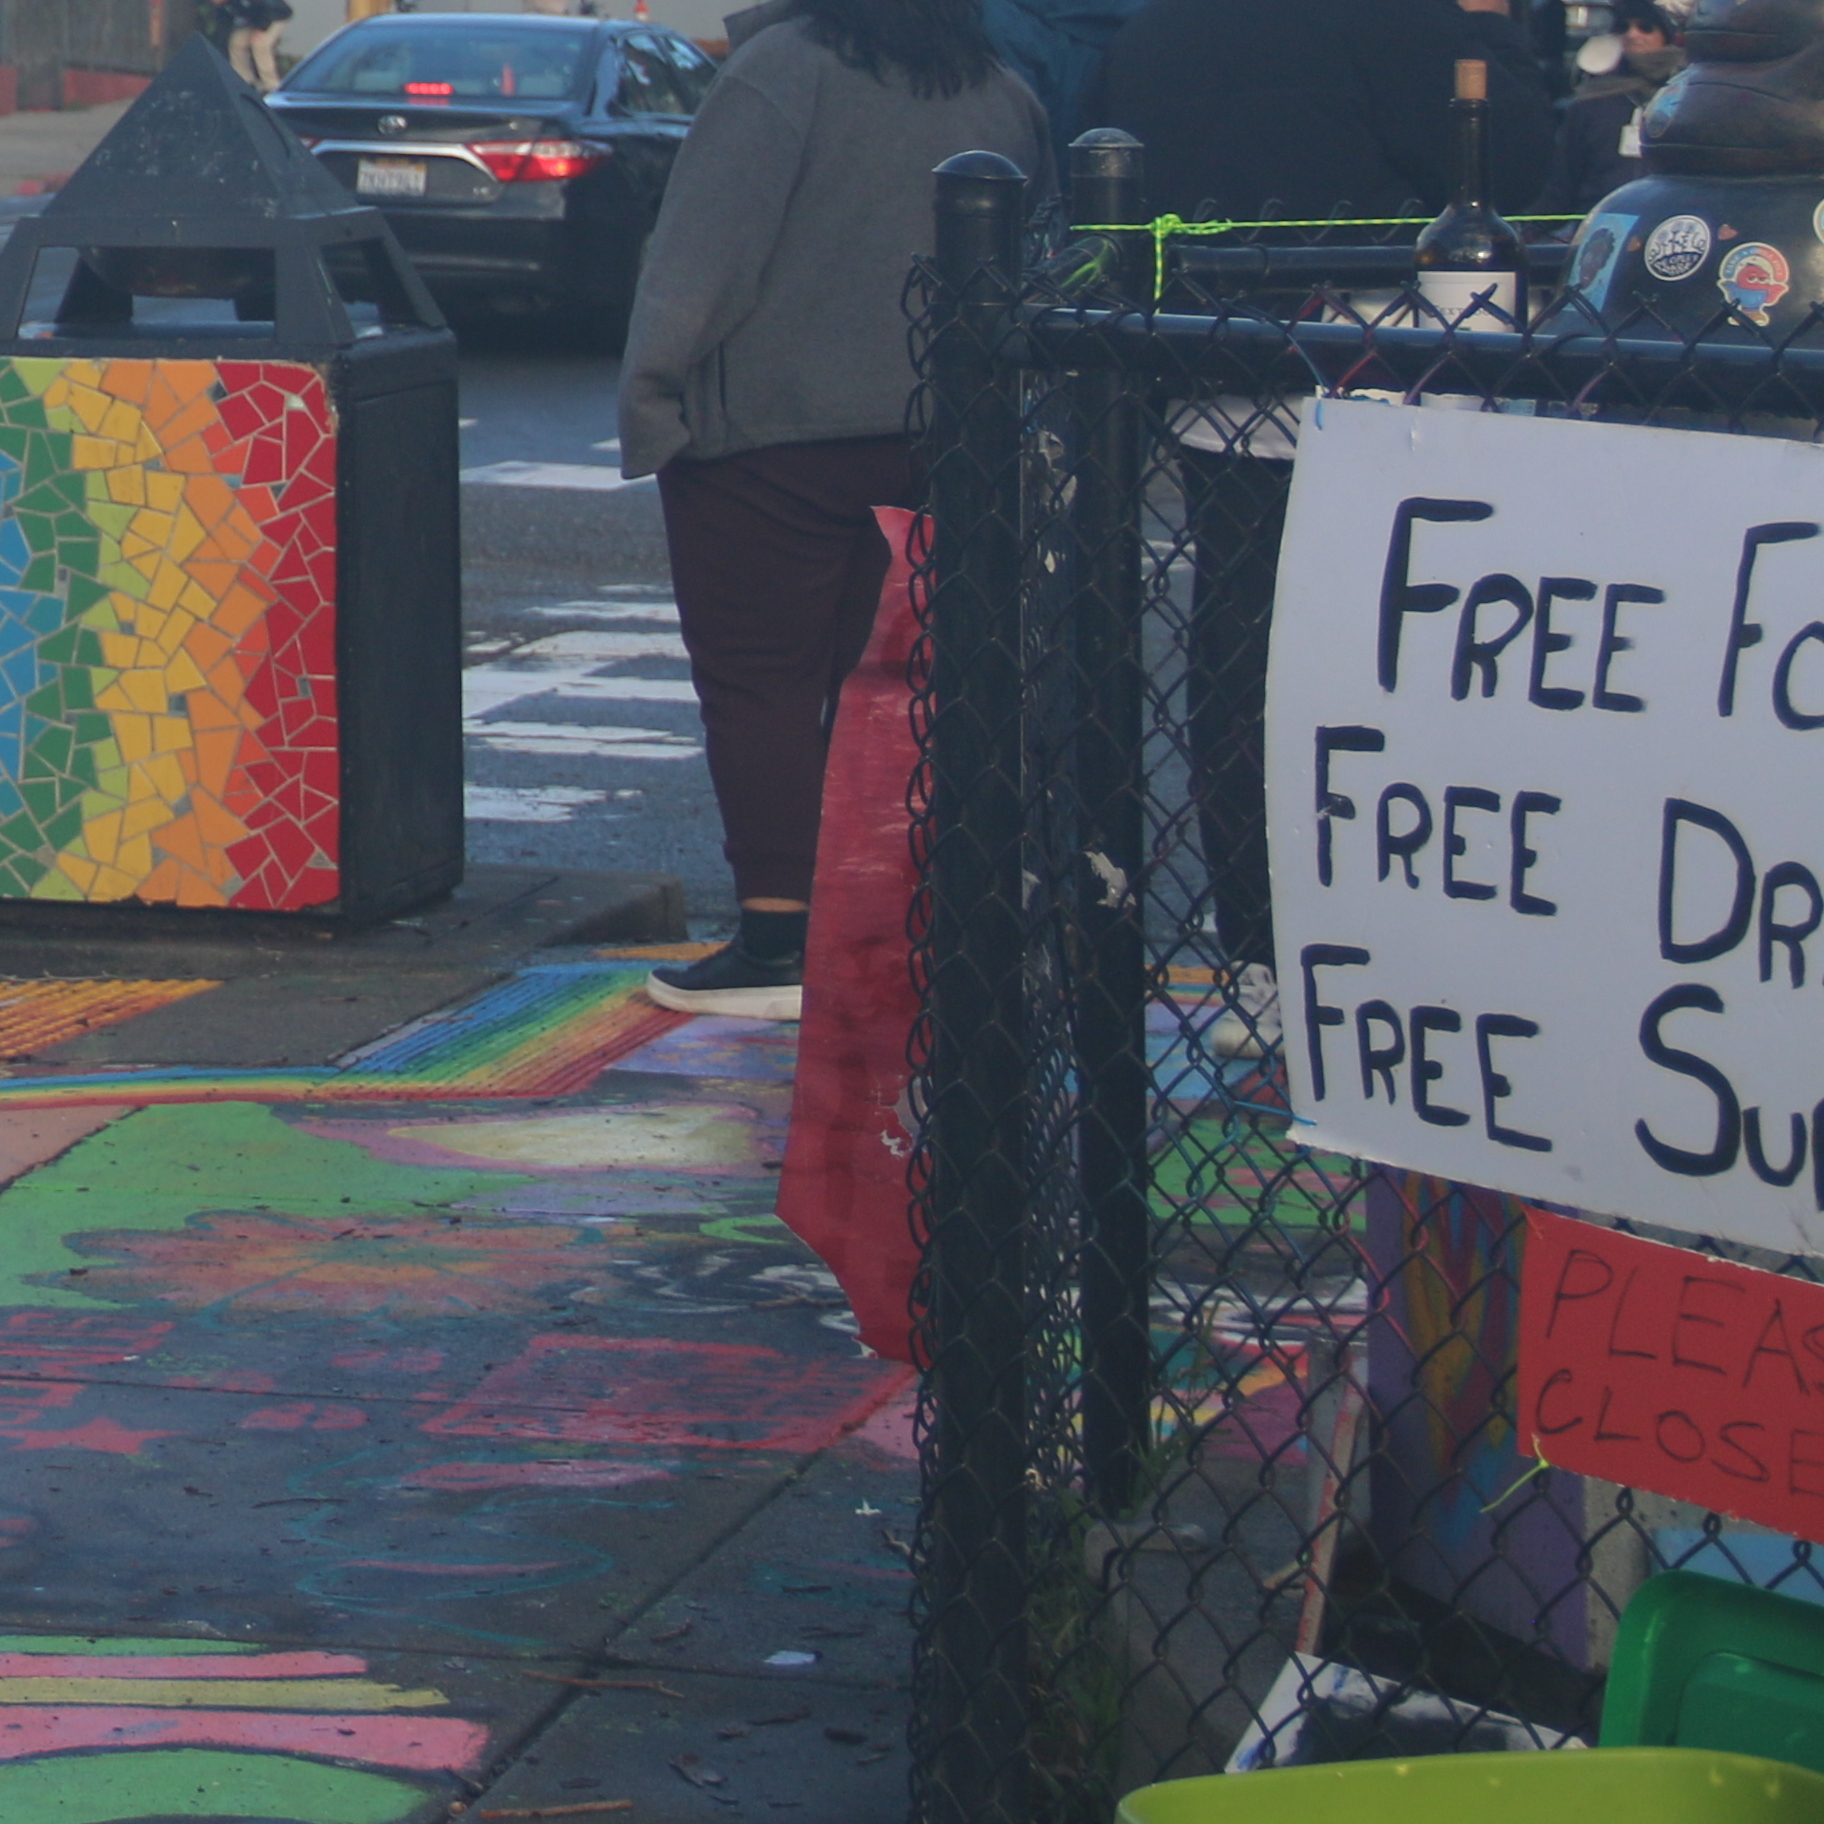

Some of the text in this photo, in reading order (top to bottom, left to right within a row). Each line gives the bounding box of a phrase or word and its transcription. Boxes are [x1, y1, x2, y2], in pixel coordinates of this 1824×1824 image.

[1378, 496, 1668, 714] FREE
[1315, 725, 1562, 916] FREE
[1301, 944, 1824, 1211] FREE SU
